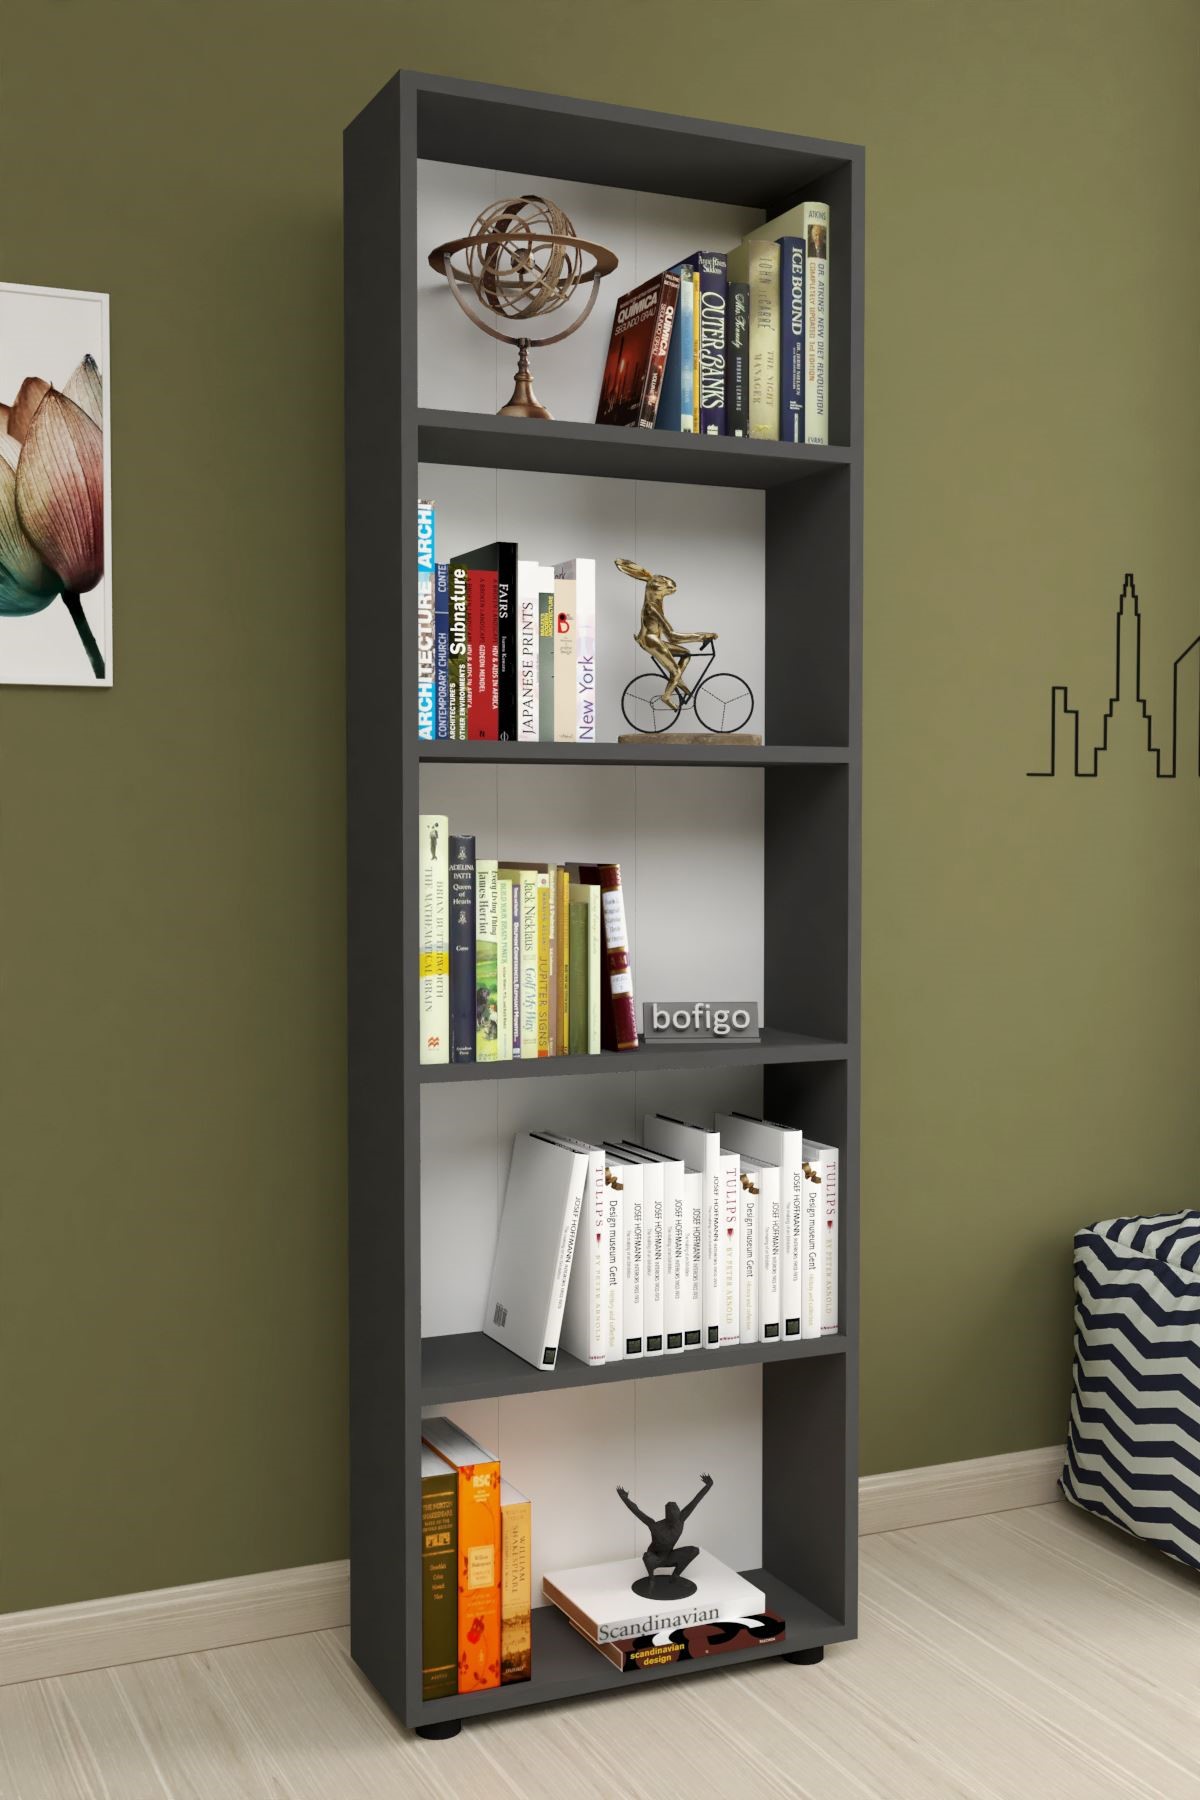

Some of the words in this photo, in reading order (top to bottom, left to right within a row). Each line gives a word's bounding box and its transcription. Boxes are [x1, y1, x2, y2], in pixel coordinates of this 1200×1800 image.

[809, 210, 826, 220] ATKINS
[758, 258, 772, 284] JOHN
[792, 246, 803, 274] ICE
[614, 316, 641, 336] SEGUNDO
[640, 306, 656, 322] GRAU
[654, 303, 667, 336] SEGUNDO
[702, 292, 726, 350] OUTER
[792, 276, 803, 336] BOUND
[700, 348, 726, 408] BANKS
[752, 354, 762, 404] MANAGER
[766, 376, 774, 406] NIGHT
[816, 362, 824, 416] REVOLUTION
[418, 499, 434, 569] ARCHI
[438, 560, 446, 592] CONTE
[450, 568, 466, 656] Subnature
[499, 584, 508, 618] FAIRS
[522, 602, 534, 658] PRINTS
[418, 574, 433, 740] ARCHITECTURE
[438, 632, 447, 667] CHURCH
[458, 664, 466, 718] ENVIRONMENTS
[578, 656, 594, 694] York
[438, 668, 447, 738] CONTEMPORARY
[522, 660, 536, 734] JAPANESE
[458, 719, 466, 740] OTHER
[580, 700, 594, 740] New
[424, 866, 432, 890] THE
[478, 871, 488, 899] James
[524, 880, 536, 902] Jack
[479, 901, 488, 934] Herriot
[524, 906, 536, 951] Nicklaus
[424, 893, 432, 976] MATHEMATICAL
[524, 968, 536, 989] Golf
[539, 956, 548, 1006] JUPITER
[424, 980, 432, 1012] BRAIN
[524, 992, 536, 1008] My
[524, 1010, 536, 1032] Way
[539, 1012, 548, 1046] SIGNS
[652, 1003, 750, 1034] bofigo
[726, 1168, 736, 1223] TULIPS
[826, 1162, 836, 1214] TULIPS
[573, 1196, 581, 1218] JOSEF
[607, 1200, 618, 1228] Design
[654, 1201, 662, 1219] JOSEF
[745, 1203, 754, 1227] Design
[807, 1192, 816, 1218] Design
[565, 1219, 578, 1263] HOFFMANN
[608, 1230, 617, 1264] museum
[654, 1221, 662, 1260] HOFFMANN
[746, 1229, 754, 1258] museum
[808, 1219, 816, 1250] museum
[609, 1266, 618, 1286] Gent
[746, 1260, 754, 1277] Gent
[473, 1474, 490, 1488] RSC
[600, 1608, 720, 1640] Scandinavian
[630, 1642, 685, 1660] scandinavian
[644, 1655, 672, 1666] design
